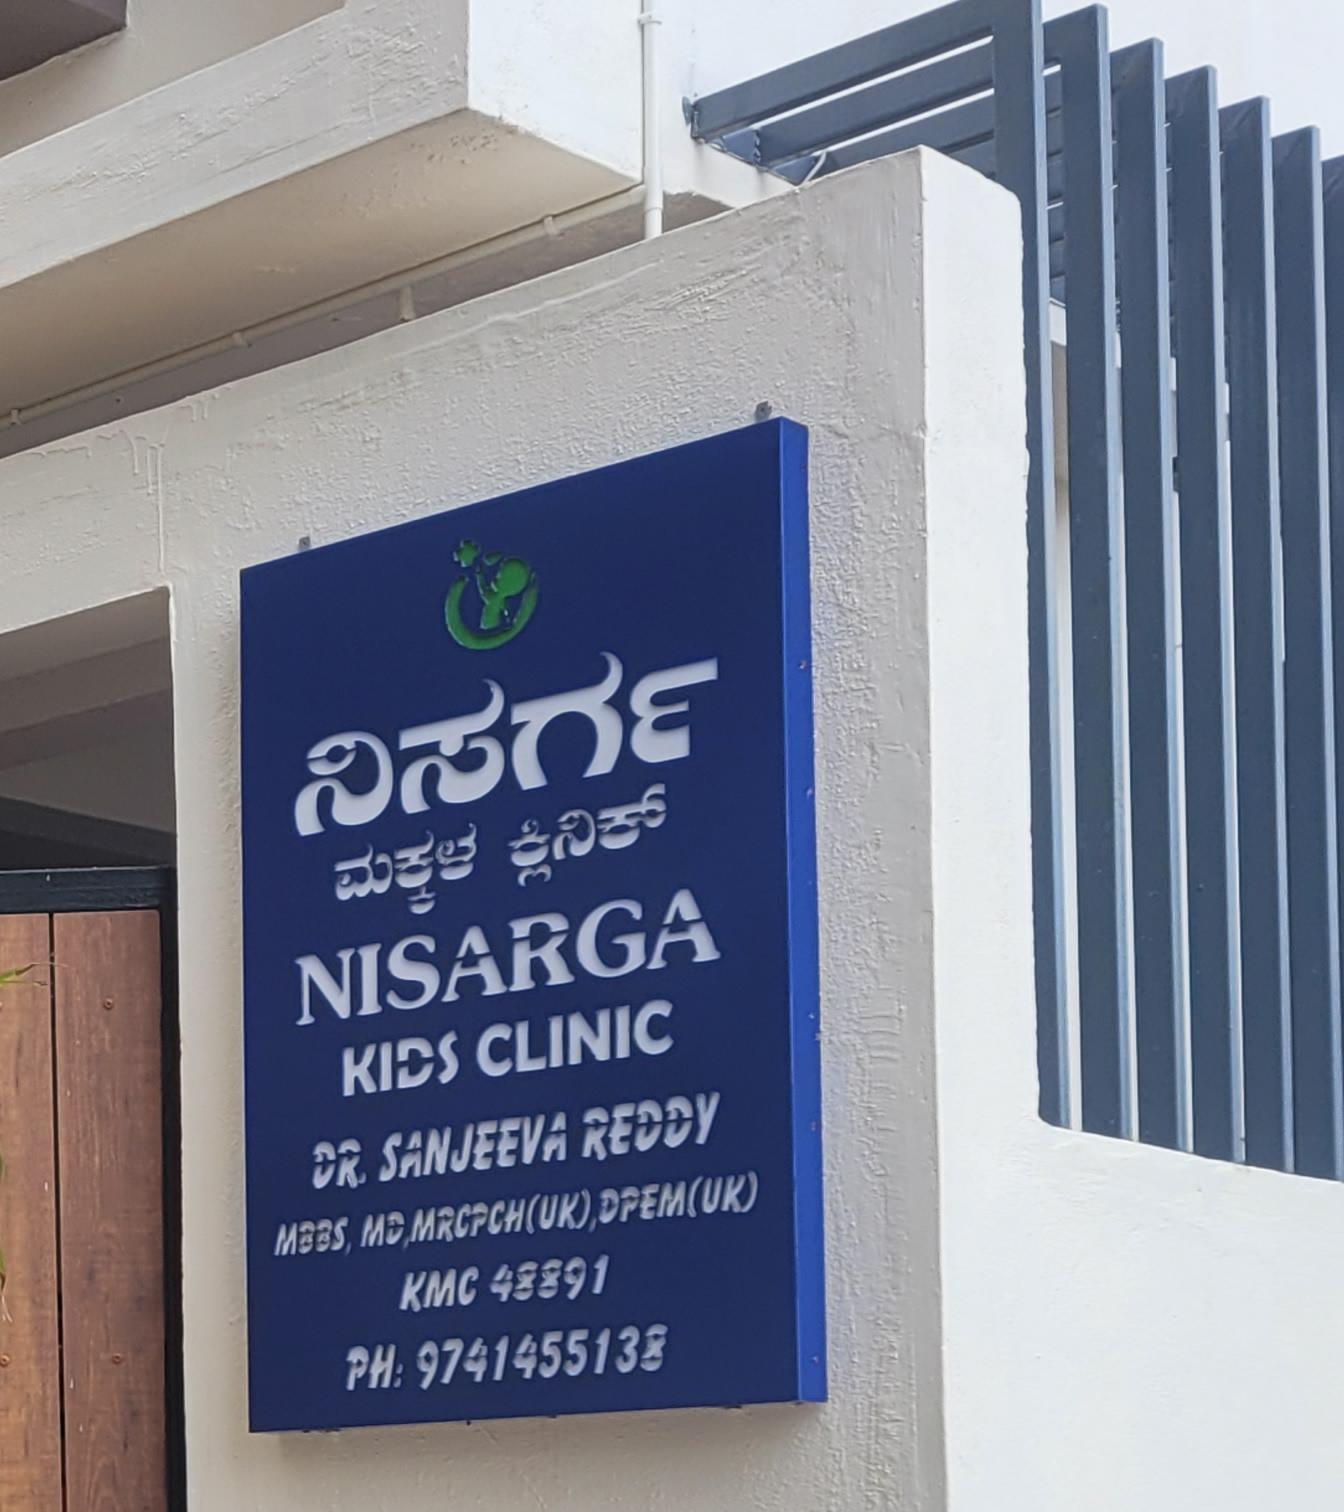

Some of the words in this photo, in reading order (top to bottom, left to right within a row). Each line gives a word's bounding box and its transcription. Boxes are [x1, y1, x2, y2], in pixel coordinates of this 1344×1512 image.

[295, 652, 718, 836] ನಿಸರ್ಗ
[334, 823, 477, 914] ಮಕ್ಕಳ
[508, 784, 667, 887] ಕ್ಲಿನಿಕ್
[295, 889, 720, 1026] NISARGA
[342, 1030, 459, 1097] KIDS
[475, 1000, 674, 1078] CLINIC
[312, 1139, 366, 1190] DR.
[378, 1112, 567, 1182] SANJEEVA
[581, 1092, 720, 1161] REDDY
[399, 1266, 479, 1312] KMC
[489, 1255, 609, 1302] 48891
[346, 1344, 403, 1391] PH:
[417, 1323, 668, 1390] 9741455138
